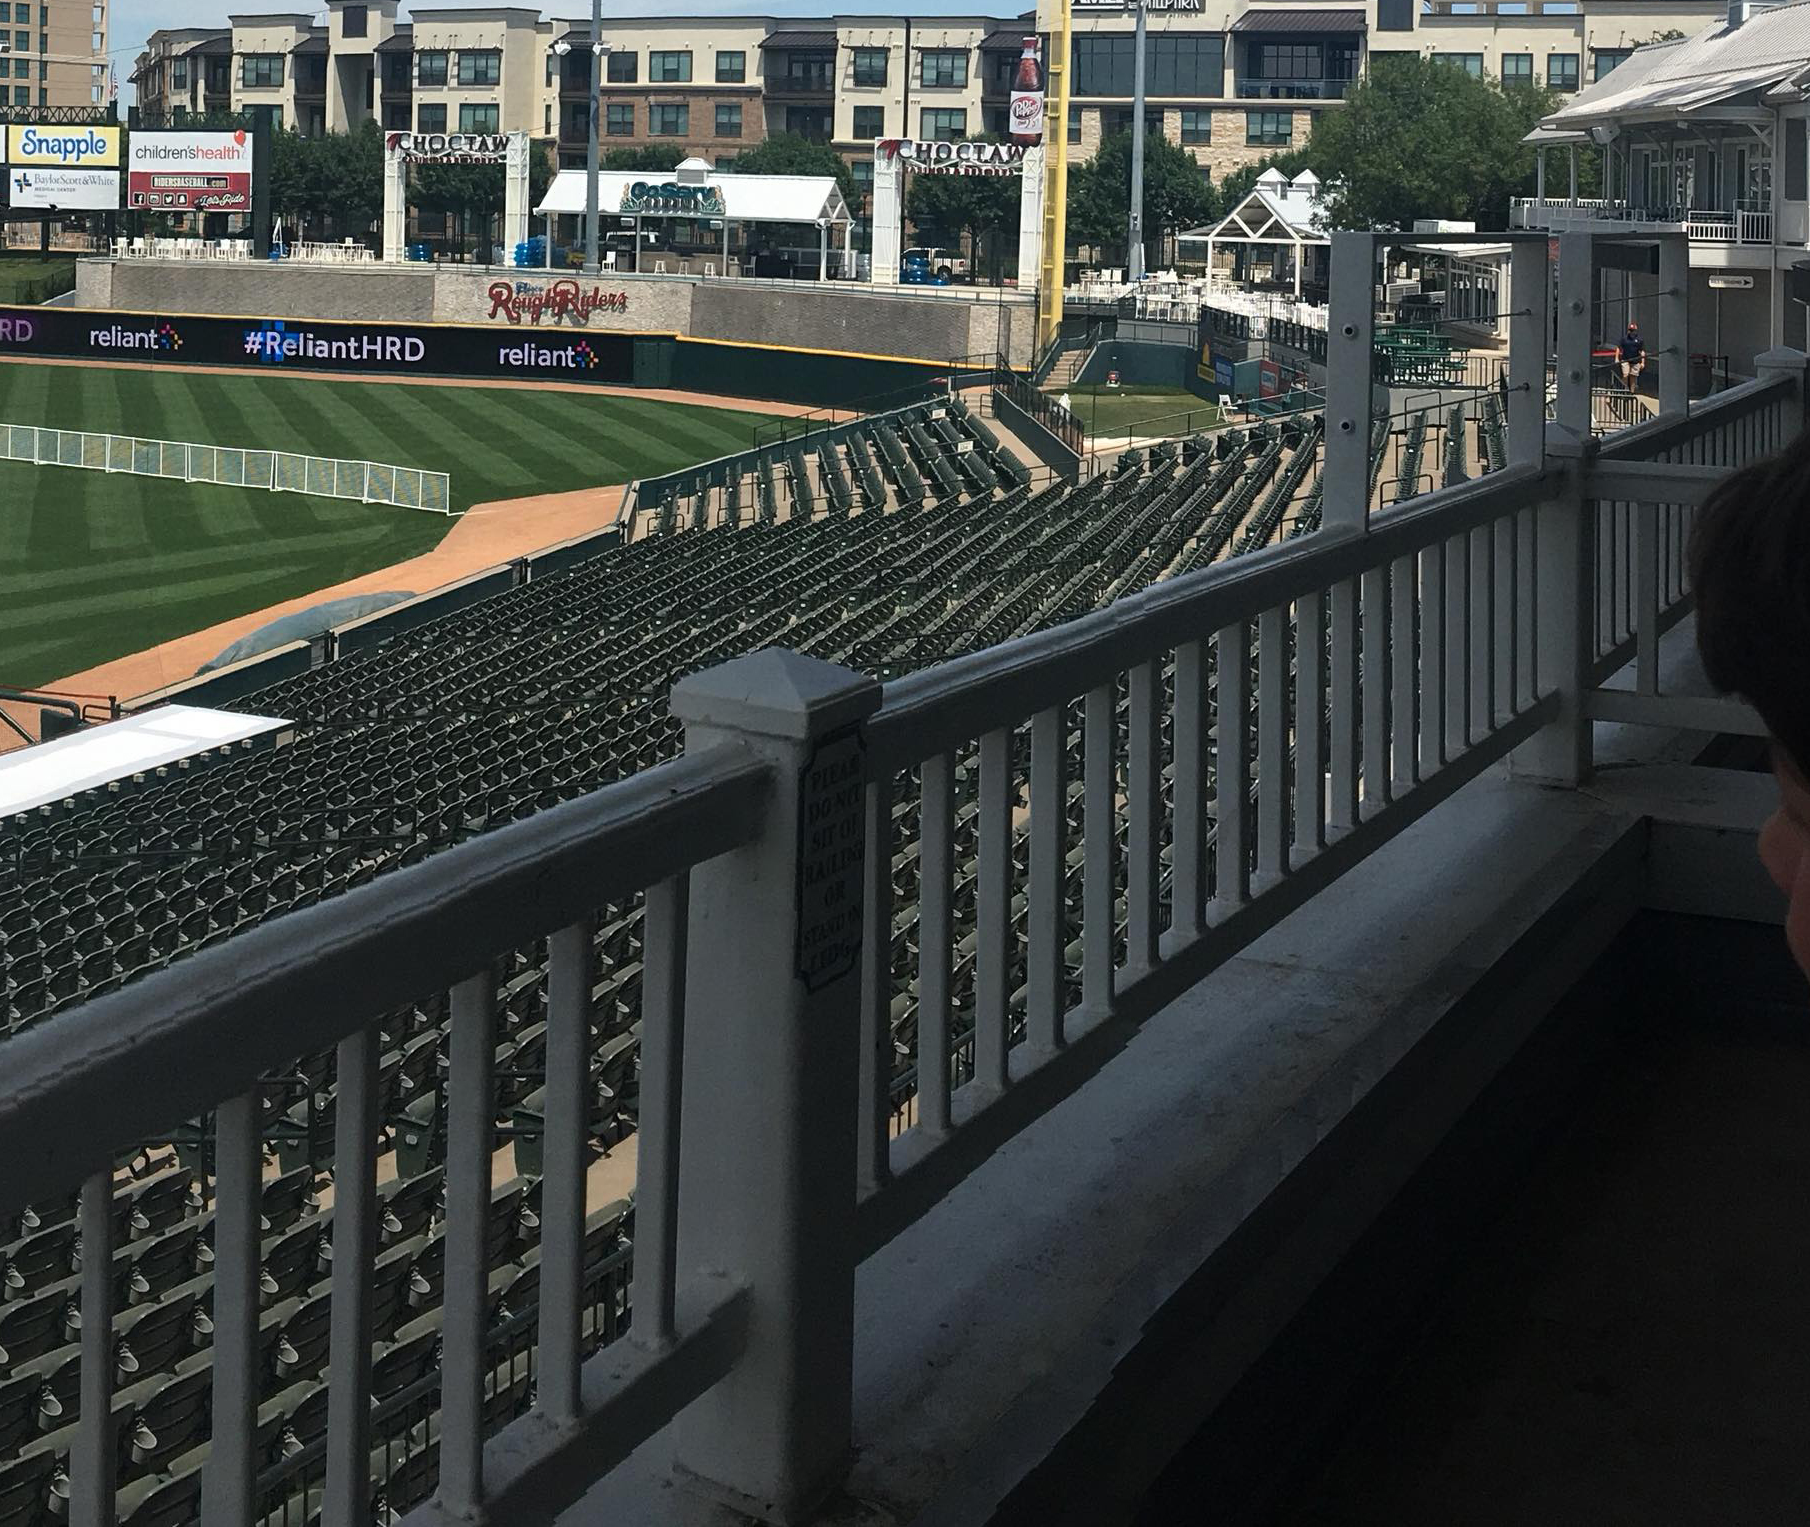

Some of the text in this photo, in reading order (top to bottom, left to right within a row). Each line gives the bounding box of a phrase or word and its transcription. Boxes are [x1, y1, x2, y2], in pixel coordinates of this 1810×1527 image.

[22, 129, 107, 161] Snapple
[398, 133, 510, 153] CHOCTAW
[899, 141, 1025, 163] CHOCTAW
[90, 327, 159, 349] reliant
[244, 331, 426, 362] #ReliantHRD
[499, 343, 577, 369] reliant
